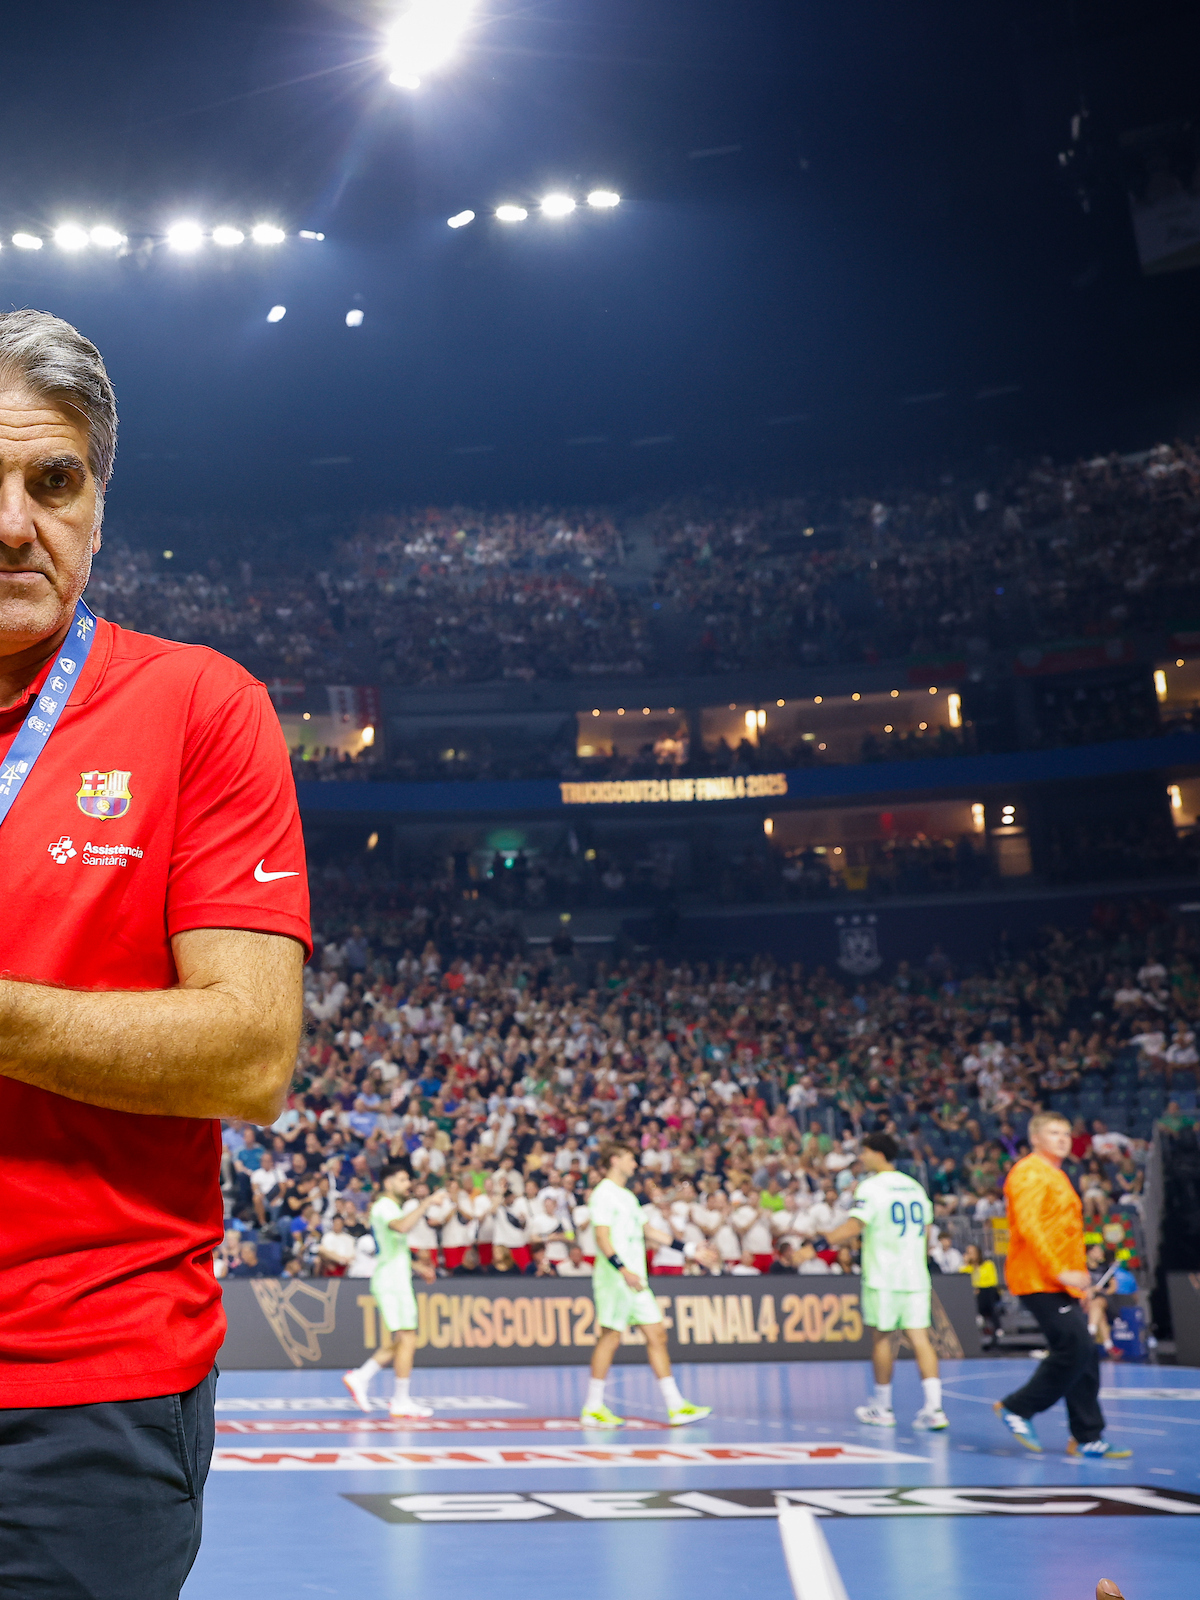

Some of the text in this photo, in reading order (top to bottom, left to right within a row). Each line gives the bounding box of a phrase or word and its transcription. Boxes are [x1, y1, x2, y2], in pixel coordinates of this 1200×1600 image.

[559, 773, 788, 804] TRUCKSCOUT24 EHF FINAL4 2025
[82, 853, 128, 867] Sanitària
[83, 841, 144, 859] Assistència
[891, 1201, 925, 1237] 99
[675, 1294, 780, 1345] FINAL4
[782, 1293, 865, 1343] 2025
[392, 1486, 1200, 1522] SELECT
